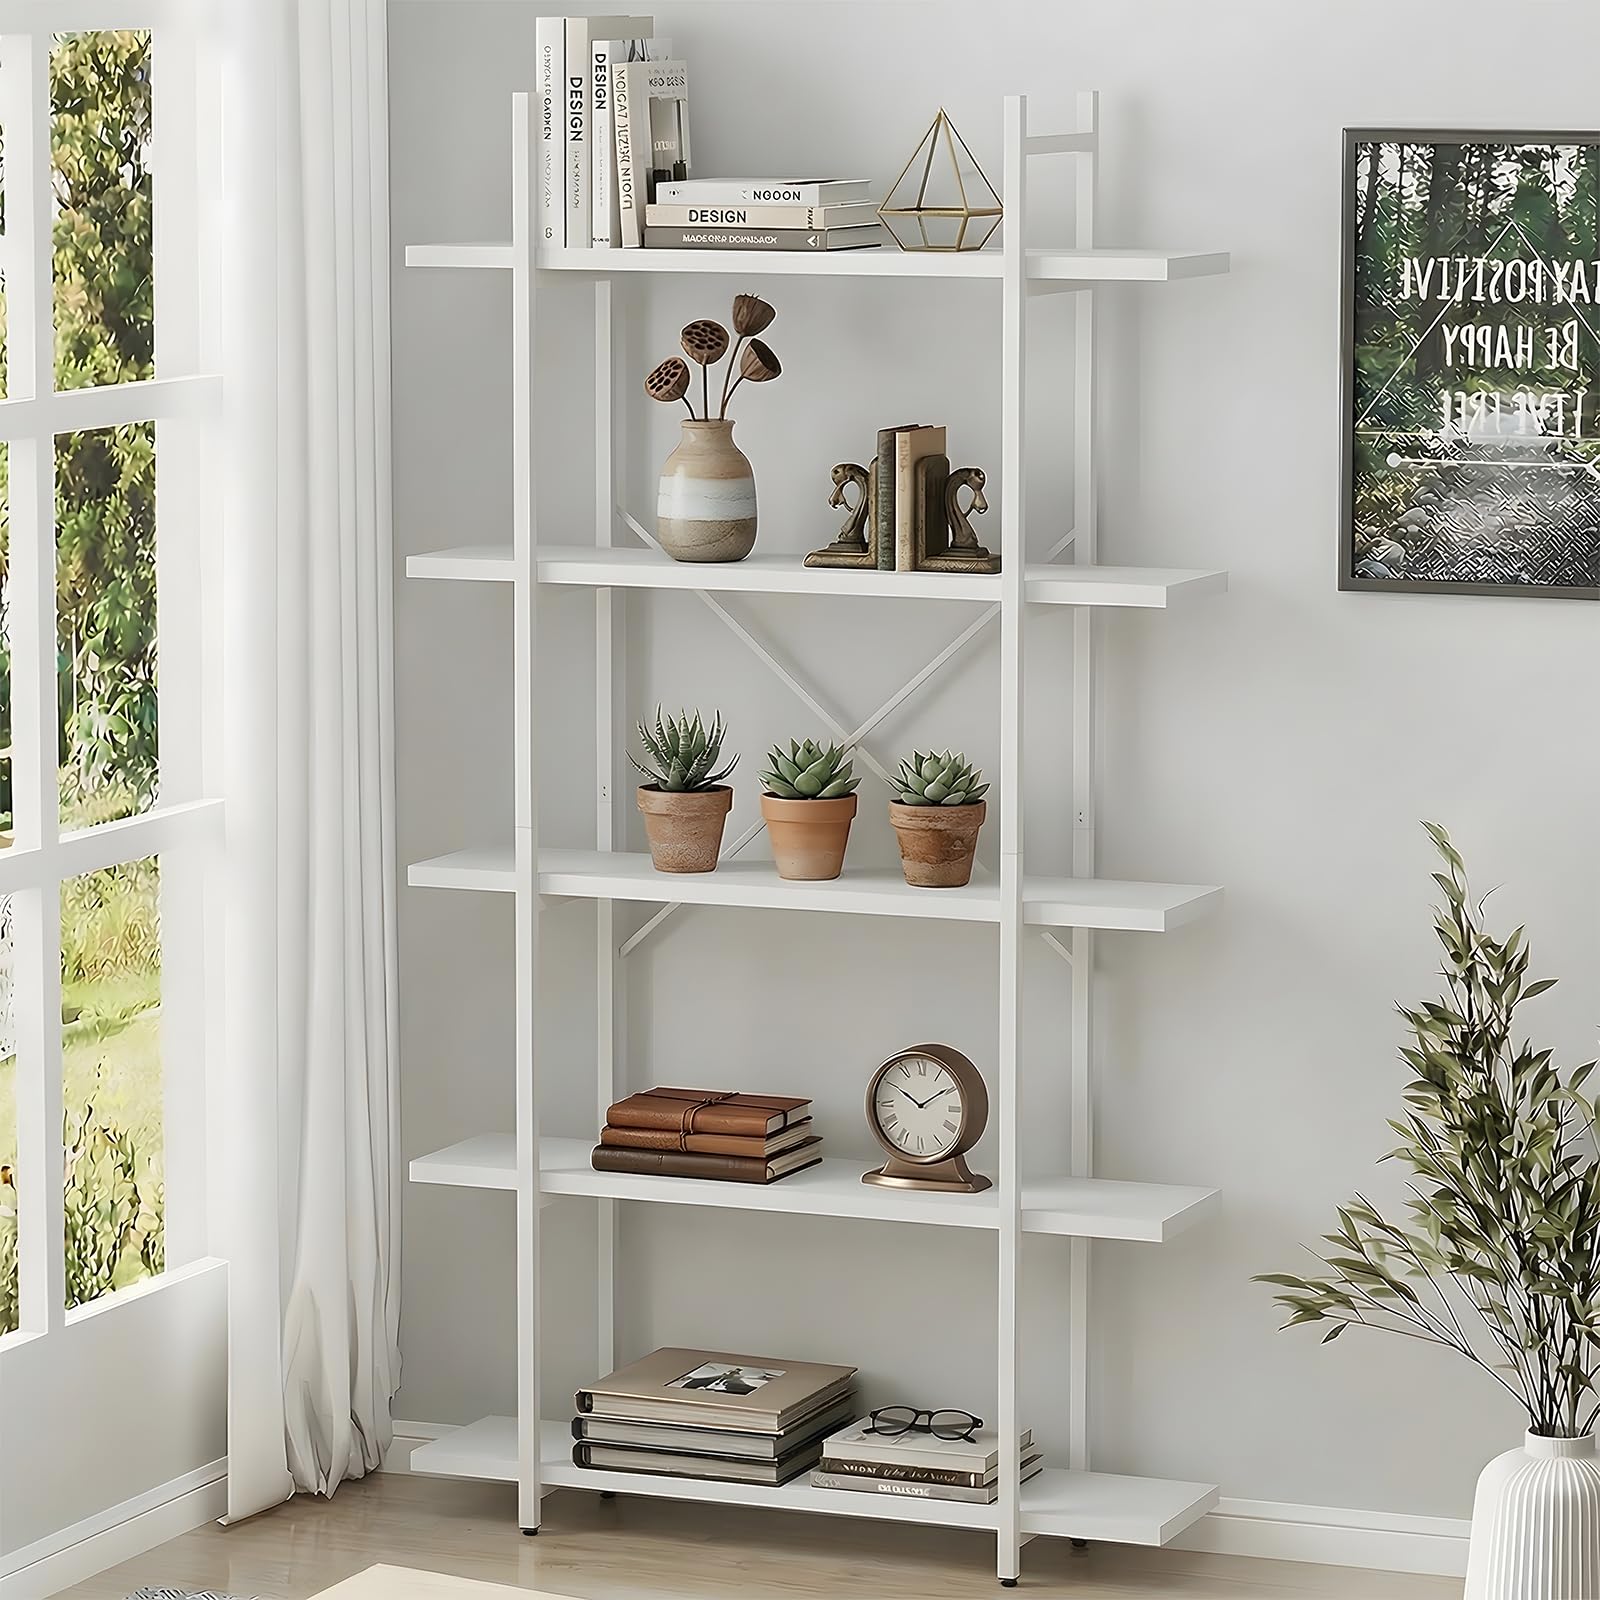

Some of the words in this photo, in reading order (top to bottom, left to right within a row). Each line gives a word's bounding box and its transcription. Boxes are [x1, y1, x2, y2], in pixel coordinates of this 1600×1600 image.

[569, 77, 584, 142] DESIGN
[595, 53, 607, 110] DESIGN
[688, 209, 746, 223] DESIGN
